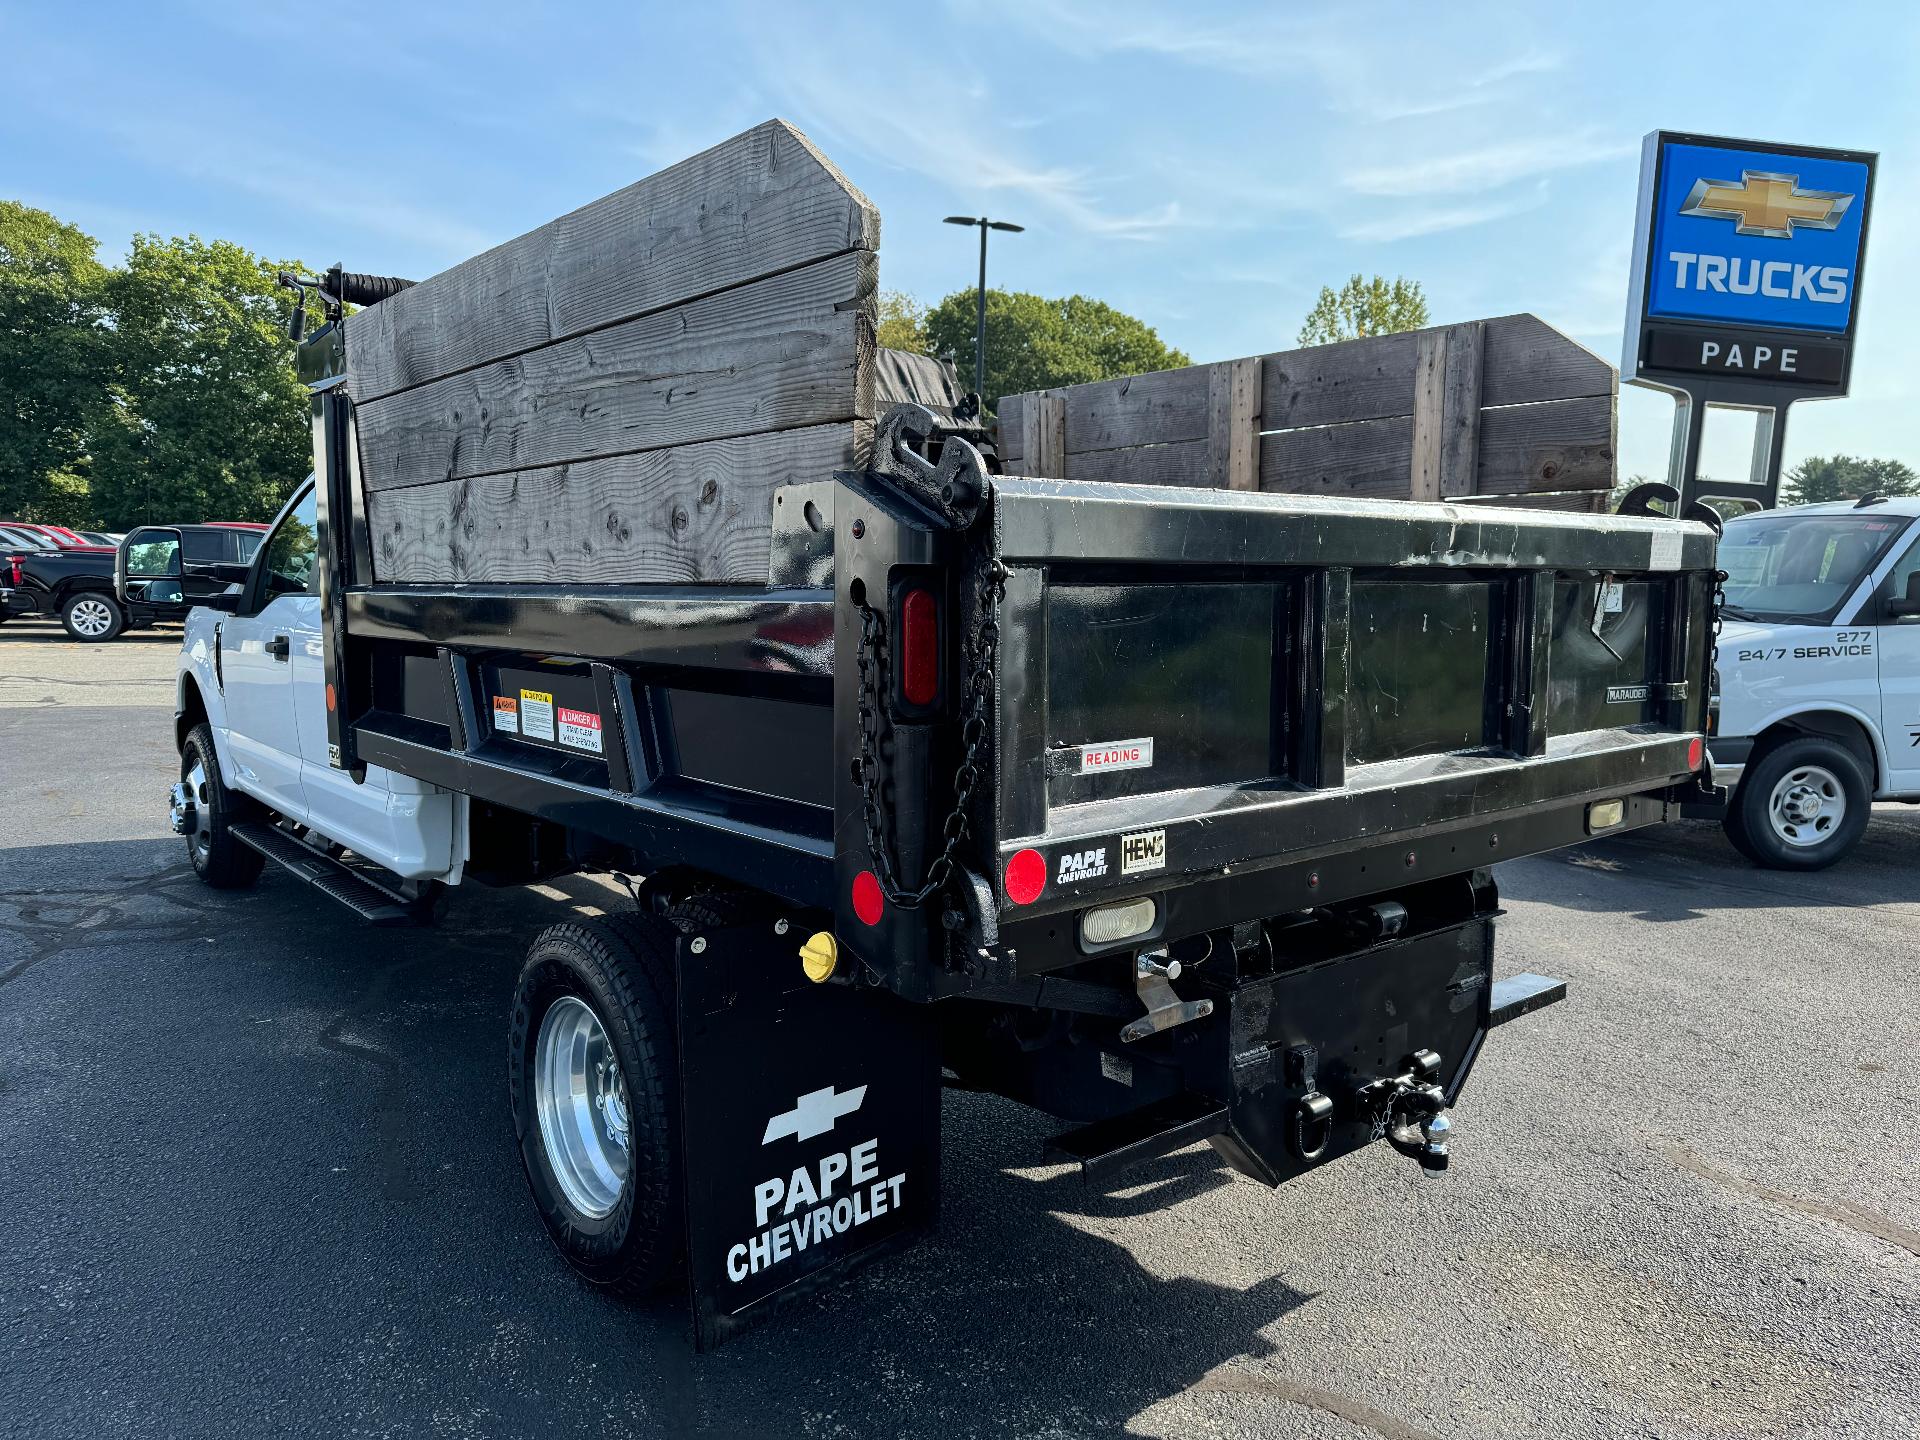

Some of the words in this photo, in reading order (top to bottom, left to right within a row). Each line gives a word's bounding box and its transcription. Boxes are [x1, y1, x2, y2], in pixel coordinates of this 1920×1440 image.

[1668, 251, 1849, 305] TRUCKS
[1701, 340, 1798, 374] PAPE
[1836, 631, 1871, 643] 277
[1738, 648, 1787, 661] 24/7
[1793, 644, 1872, 659] SERVICE
[1609, 688, 1647, 701] MARAUDER
[567, 712, 591, 725] DANGER
[1086, 748, 1140, 766] READING
[1059, 847, 1106, 873] PAPE
[1057, 864, 1108, 885] CHEVROLET
[754, 1137, 879, 1228] PAPE
[726, 1172, 906, 1283] CHEVROLET
